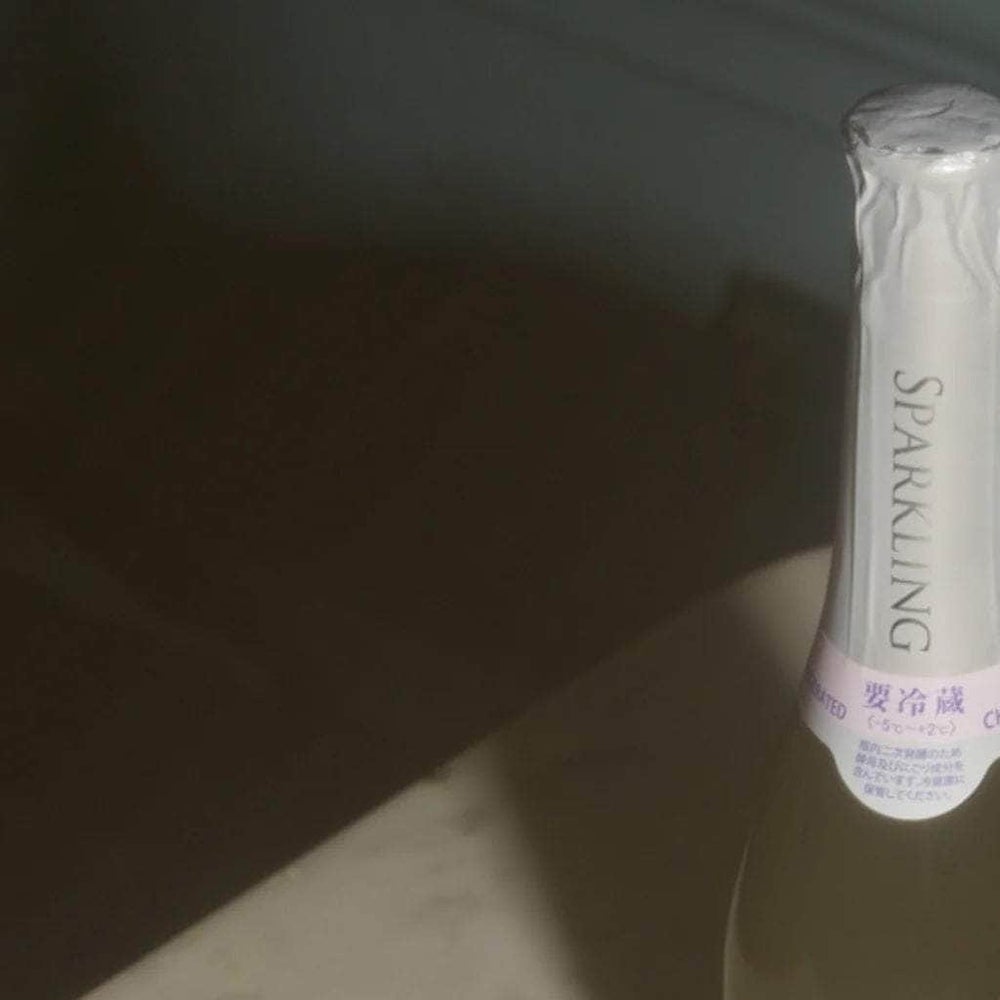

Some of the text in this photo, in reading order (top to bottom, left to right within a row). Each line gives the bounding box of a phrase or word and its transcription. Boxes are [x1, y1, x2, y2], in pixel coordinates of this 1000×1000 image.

[888, 370, 945, 654] SPARKLING
[863, 681, 965, 717] 要冷蔵
